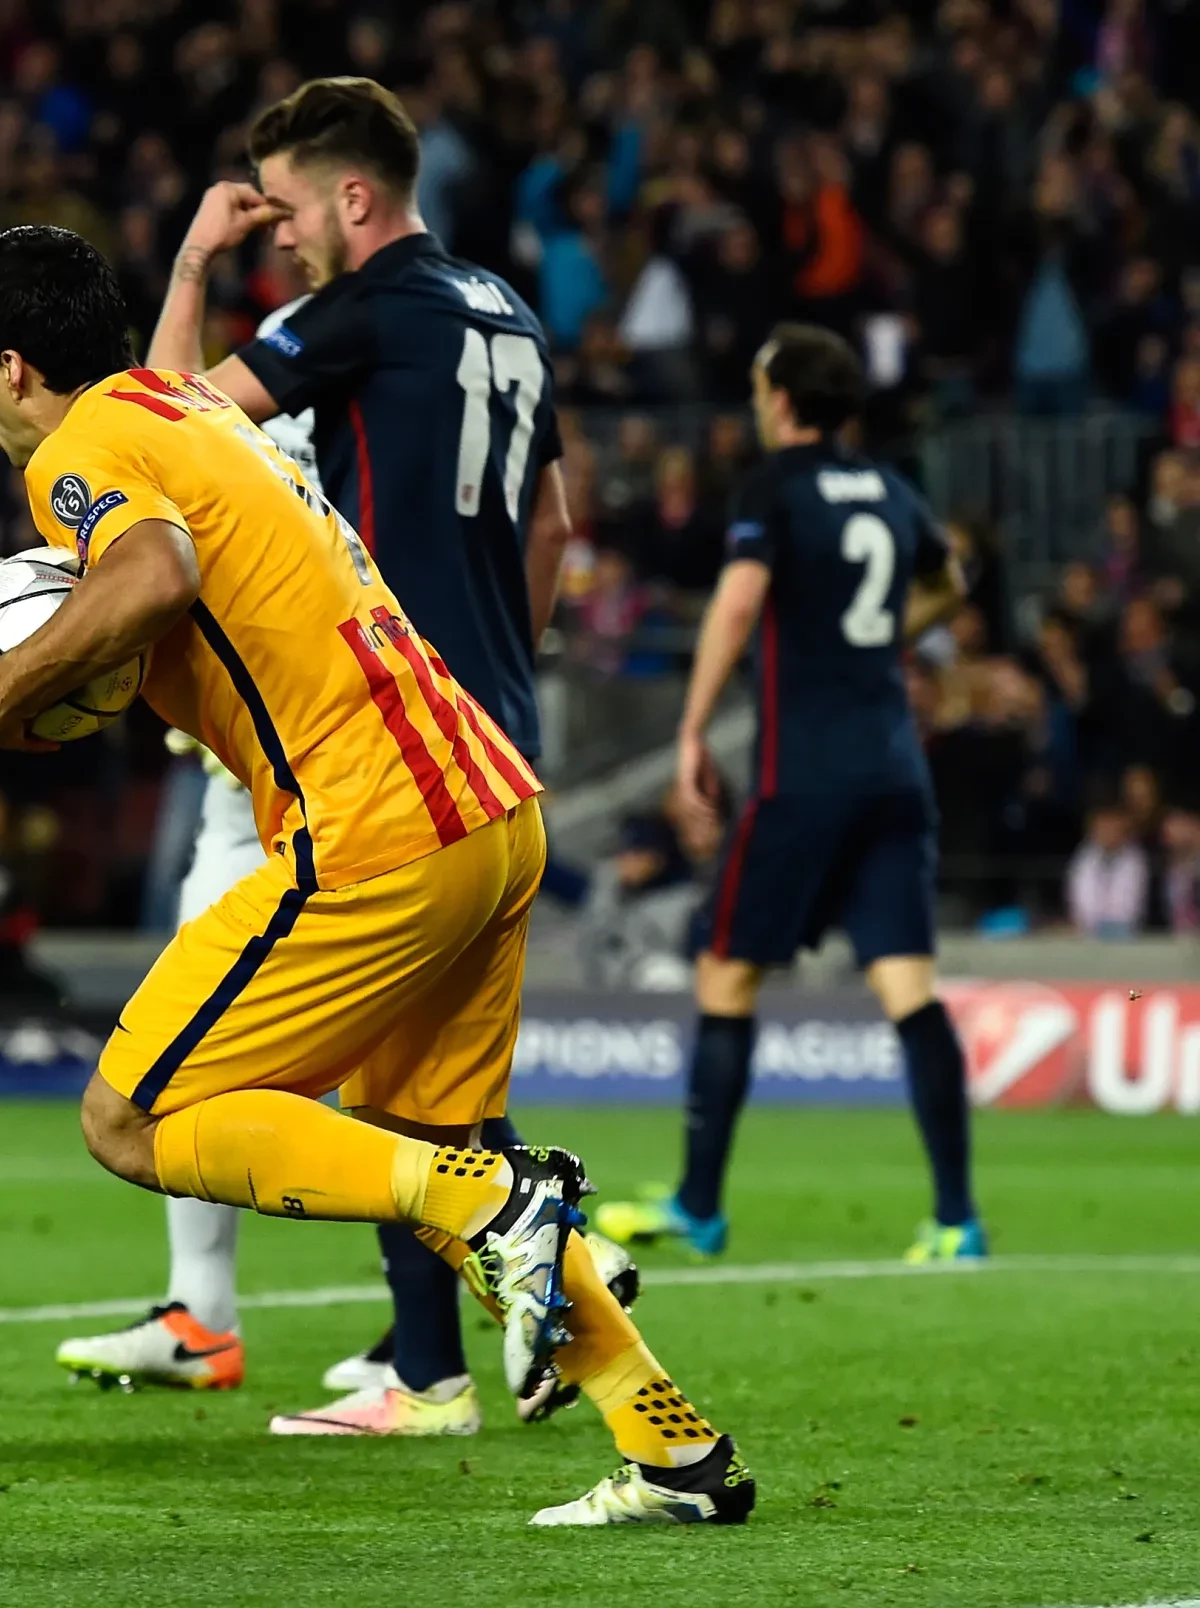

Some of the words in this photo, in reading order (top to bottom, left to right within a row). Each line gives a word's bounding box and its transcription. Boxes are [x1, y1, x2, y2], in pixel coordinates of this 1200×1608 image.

[455, 327, 544, 523] 17
[79, 492, 123, 540] RESPECT
[840, 511, 896, 648] 2
